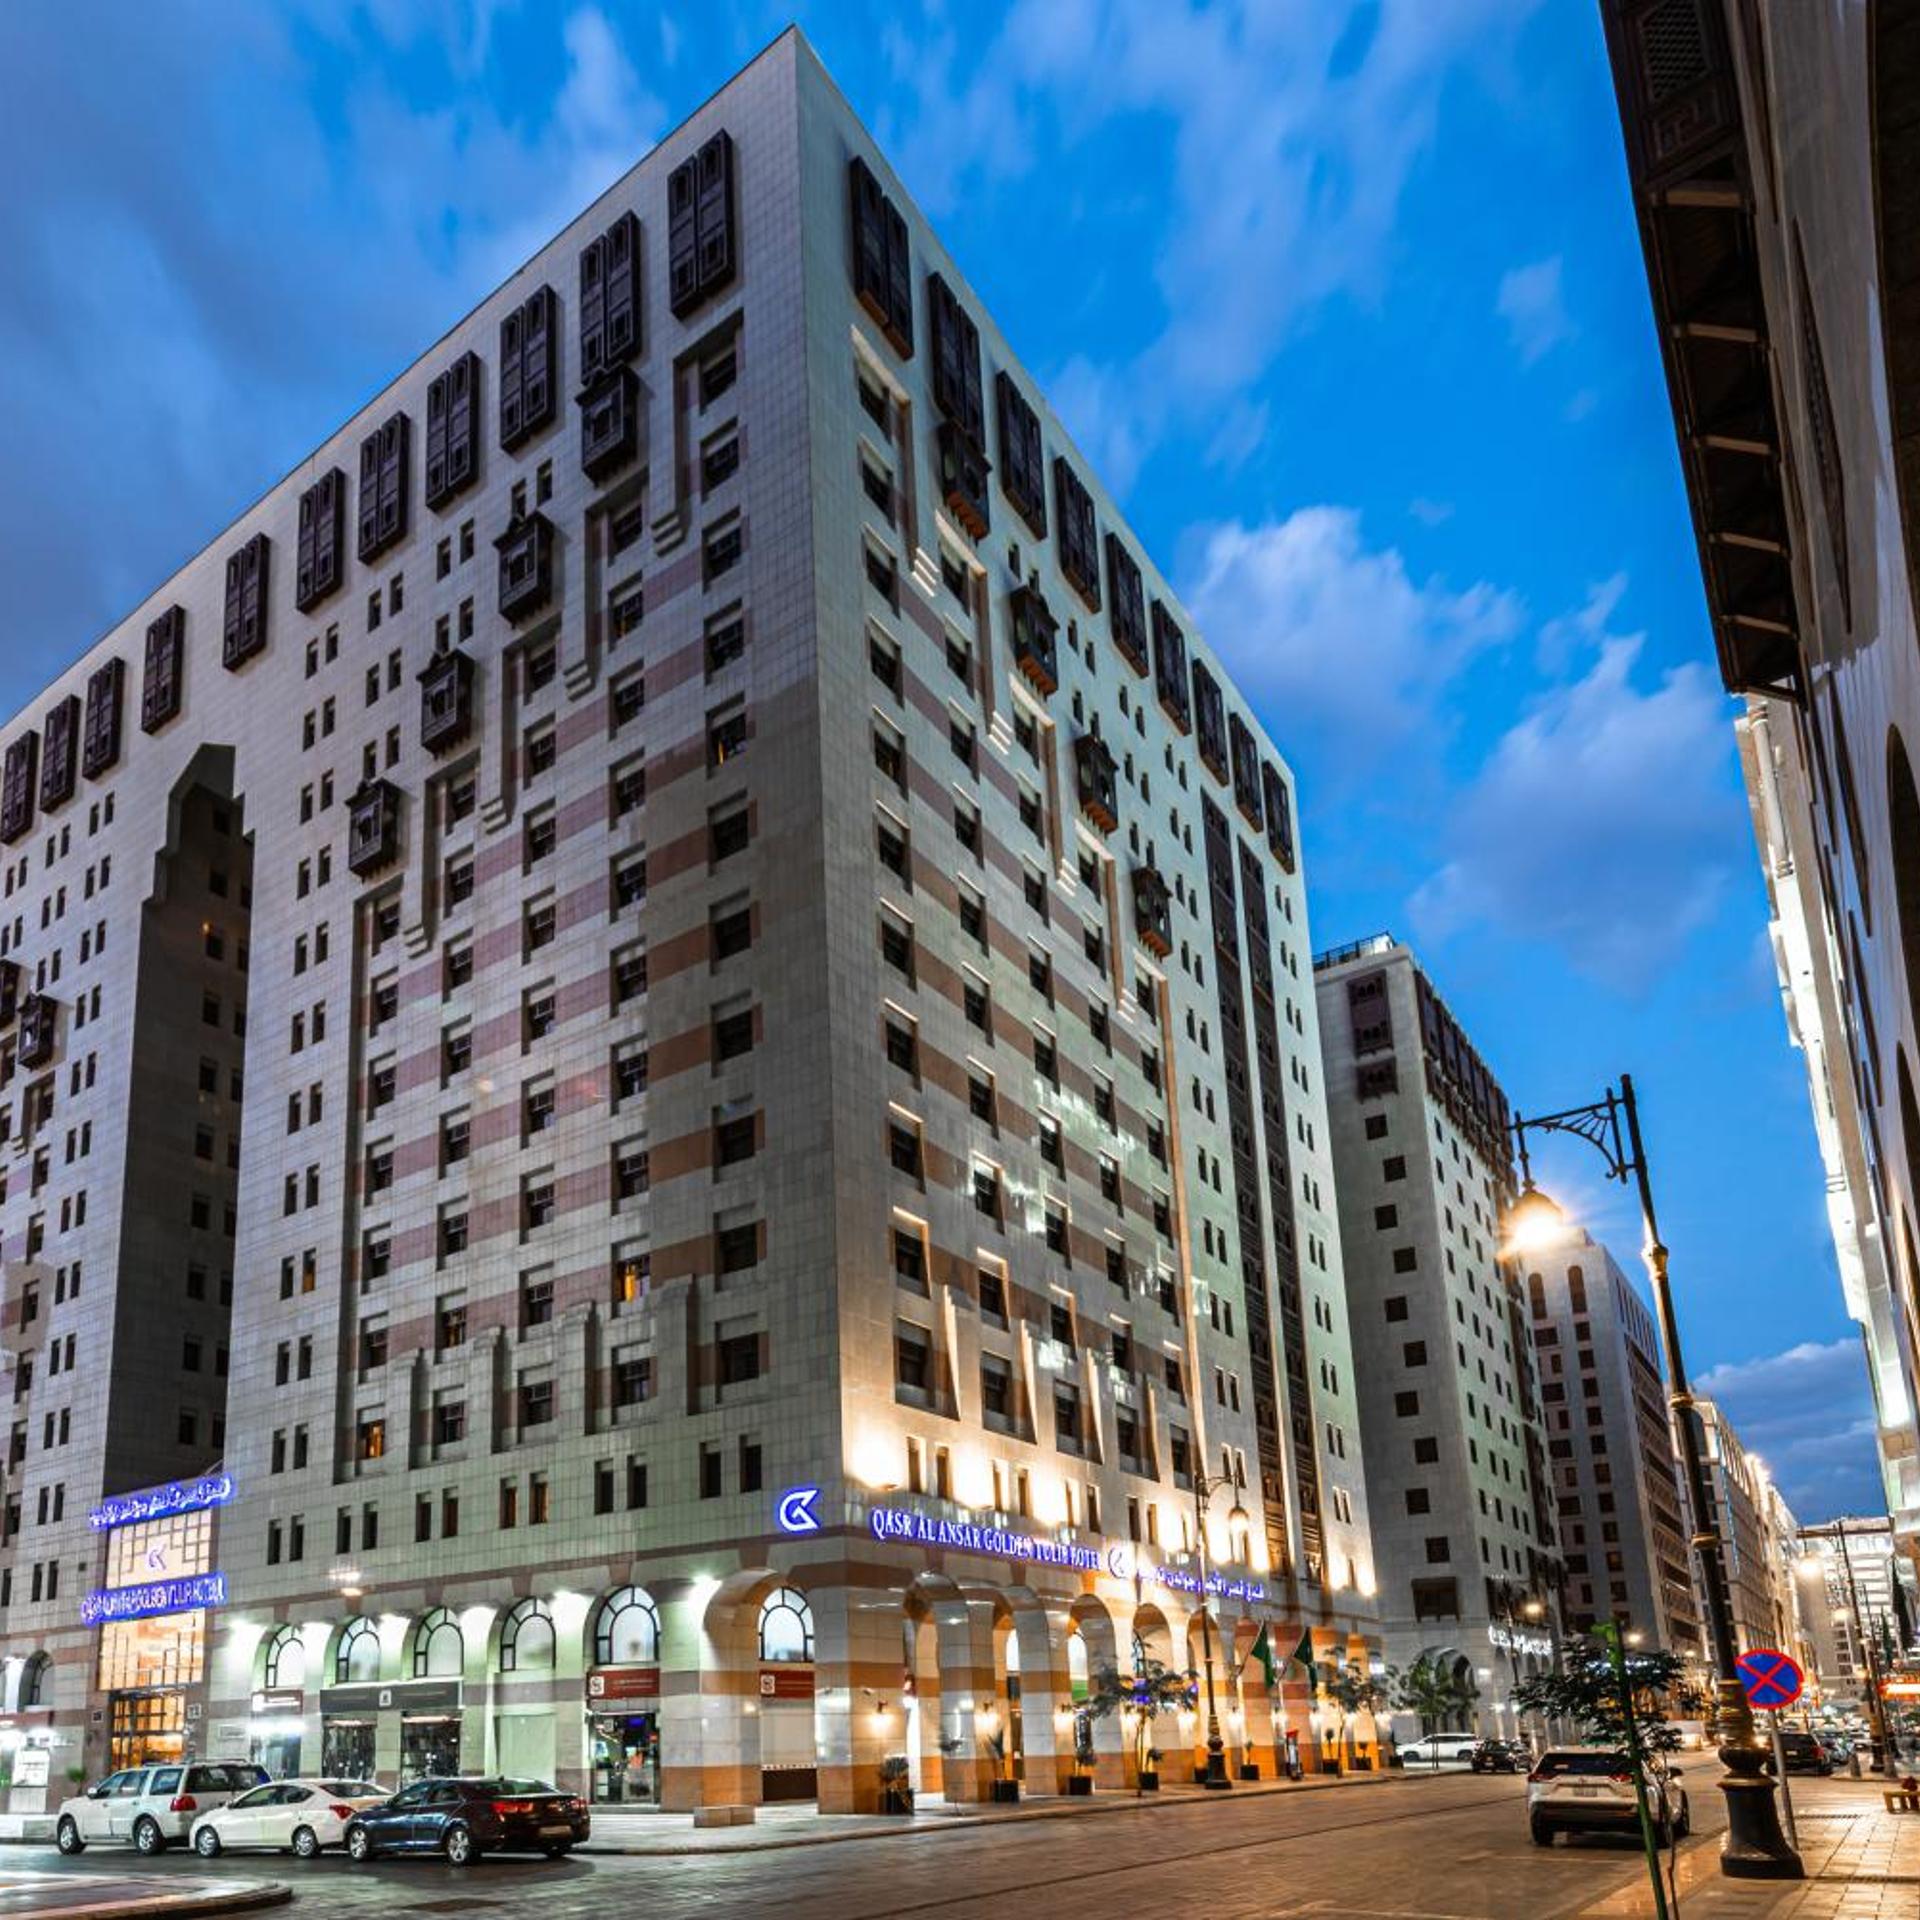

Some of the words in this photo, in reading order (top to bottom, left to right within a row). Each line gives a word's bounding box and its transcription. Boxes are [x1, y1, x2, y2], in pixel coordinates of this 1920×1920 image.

[872, 1508, 912, 1540] QASR
[937, 1519, 981, 1549] ANSAR
[983, 1527, 1032, 1559] GOLDEN
